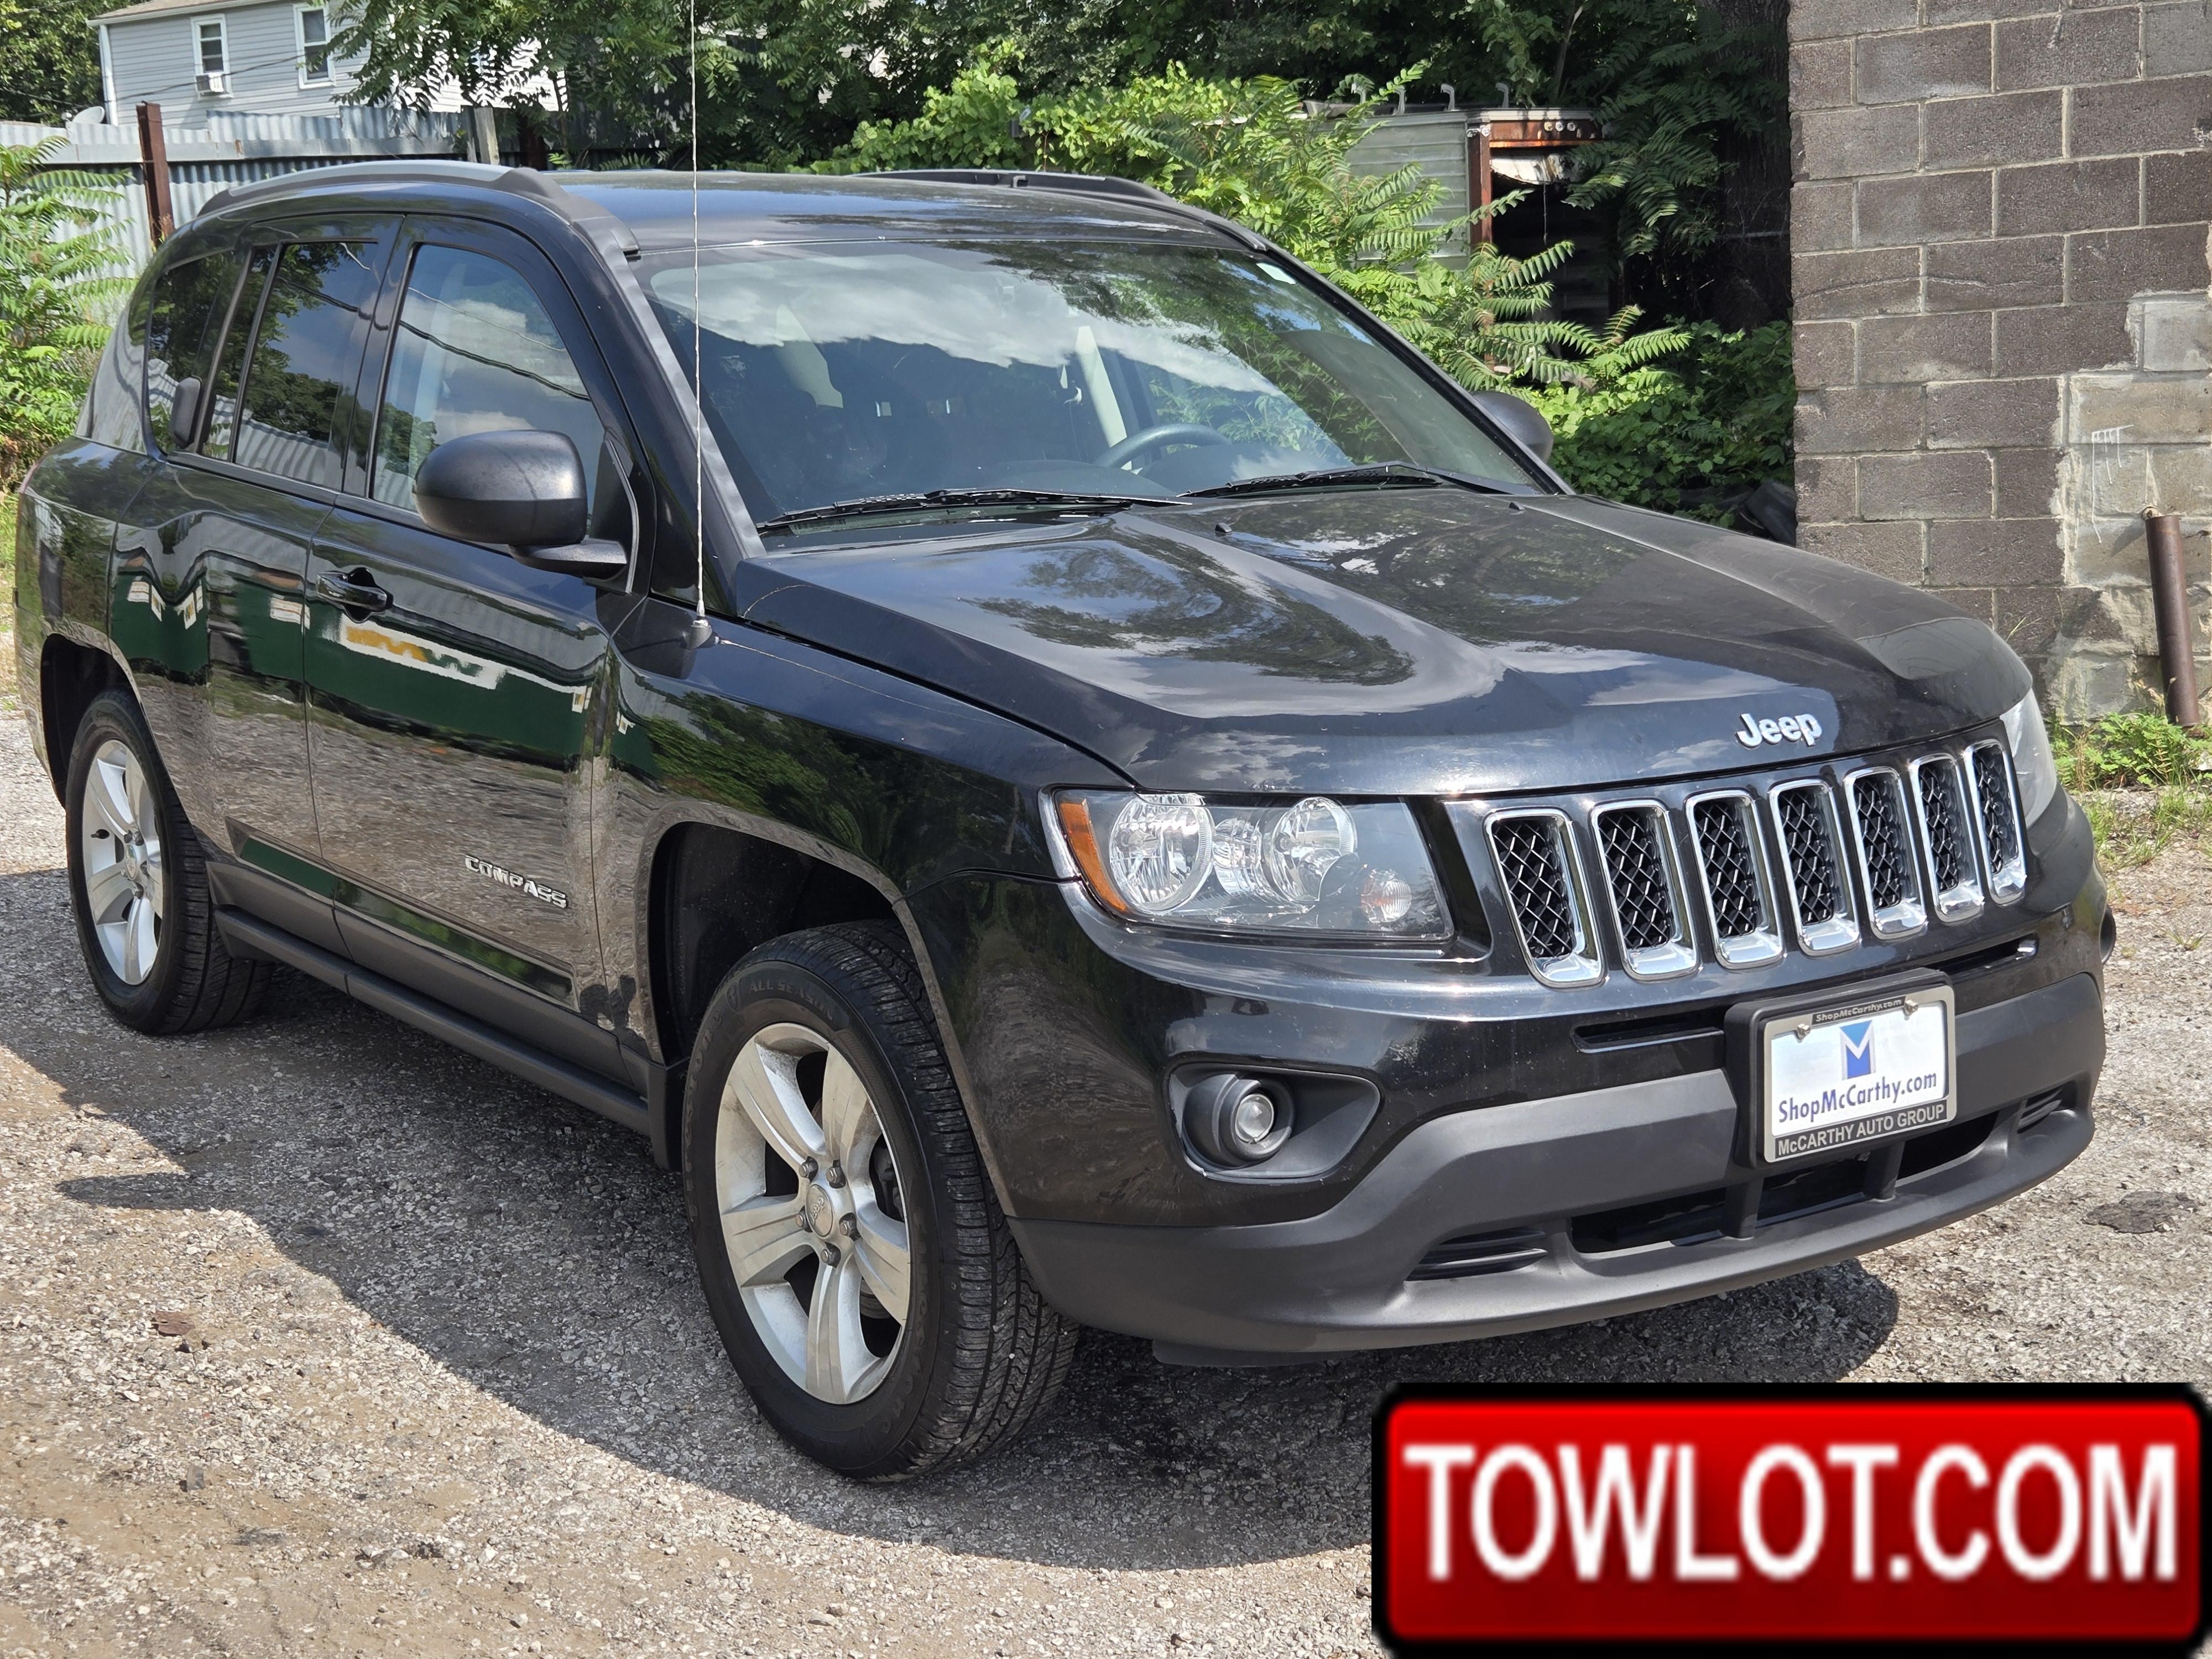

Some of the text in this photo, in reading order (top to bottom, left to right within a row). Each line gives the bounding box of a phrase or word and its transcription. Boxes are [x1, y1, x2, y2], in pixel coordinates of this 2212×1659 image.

[1736, 713, 1823, 748] Jeep
[465, 855, 567, 909] COMPASS
[750, 979, 774, 992] ALL
[1815, 999, 1902, 1022] ShopMcCarthy.com
[1778, 1072, 1937, 1123] ShopMcCarthy.com
[1778, 1104, 1944, 1156] McCARTHY AUTO GROUP
